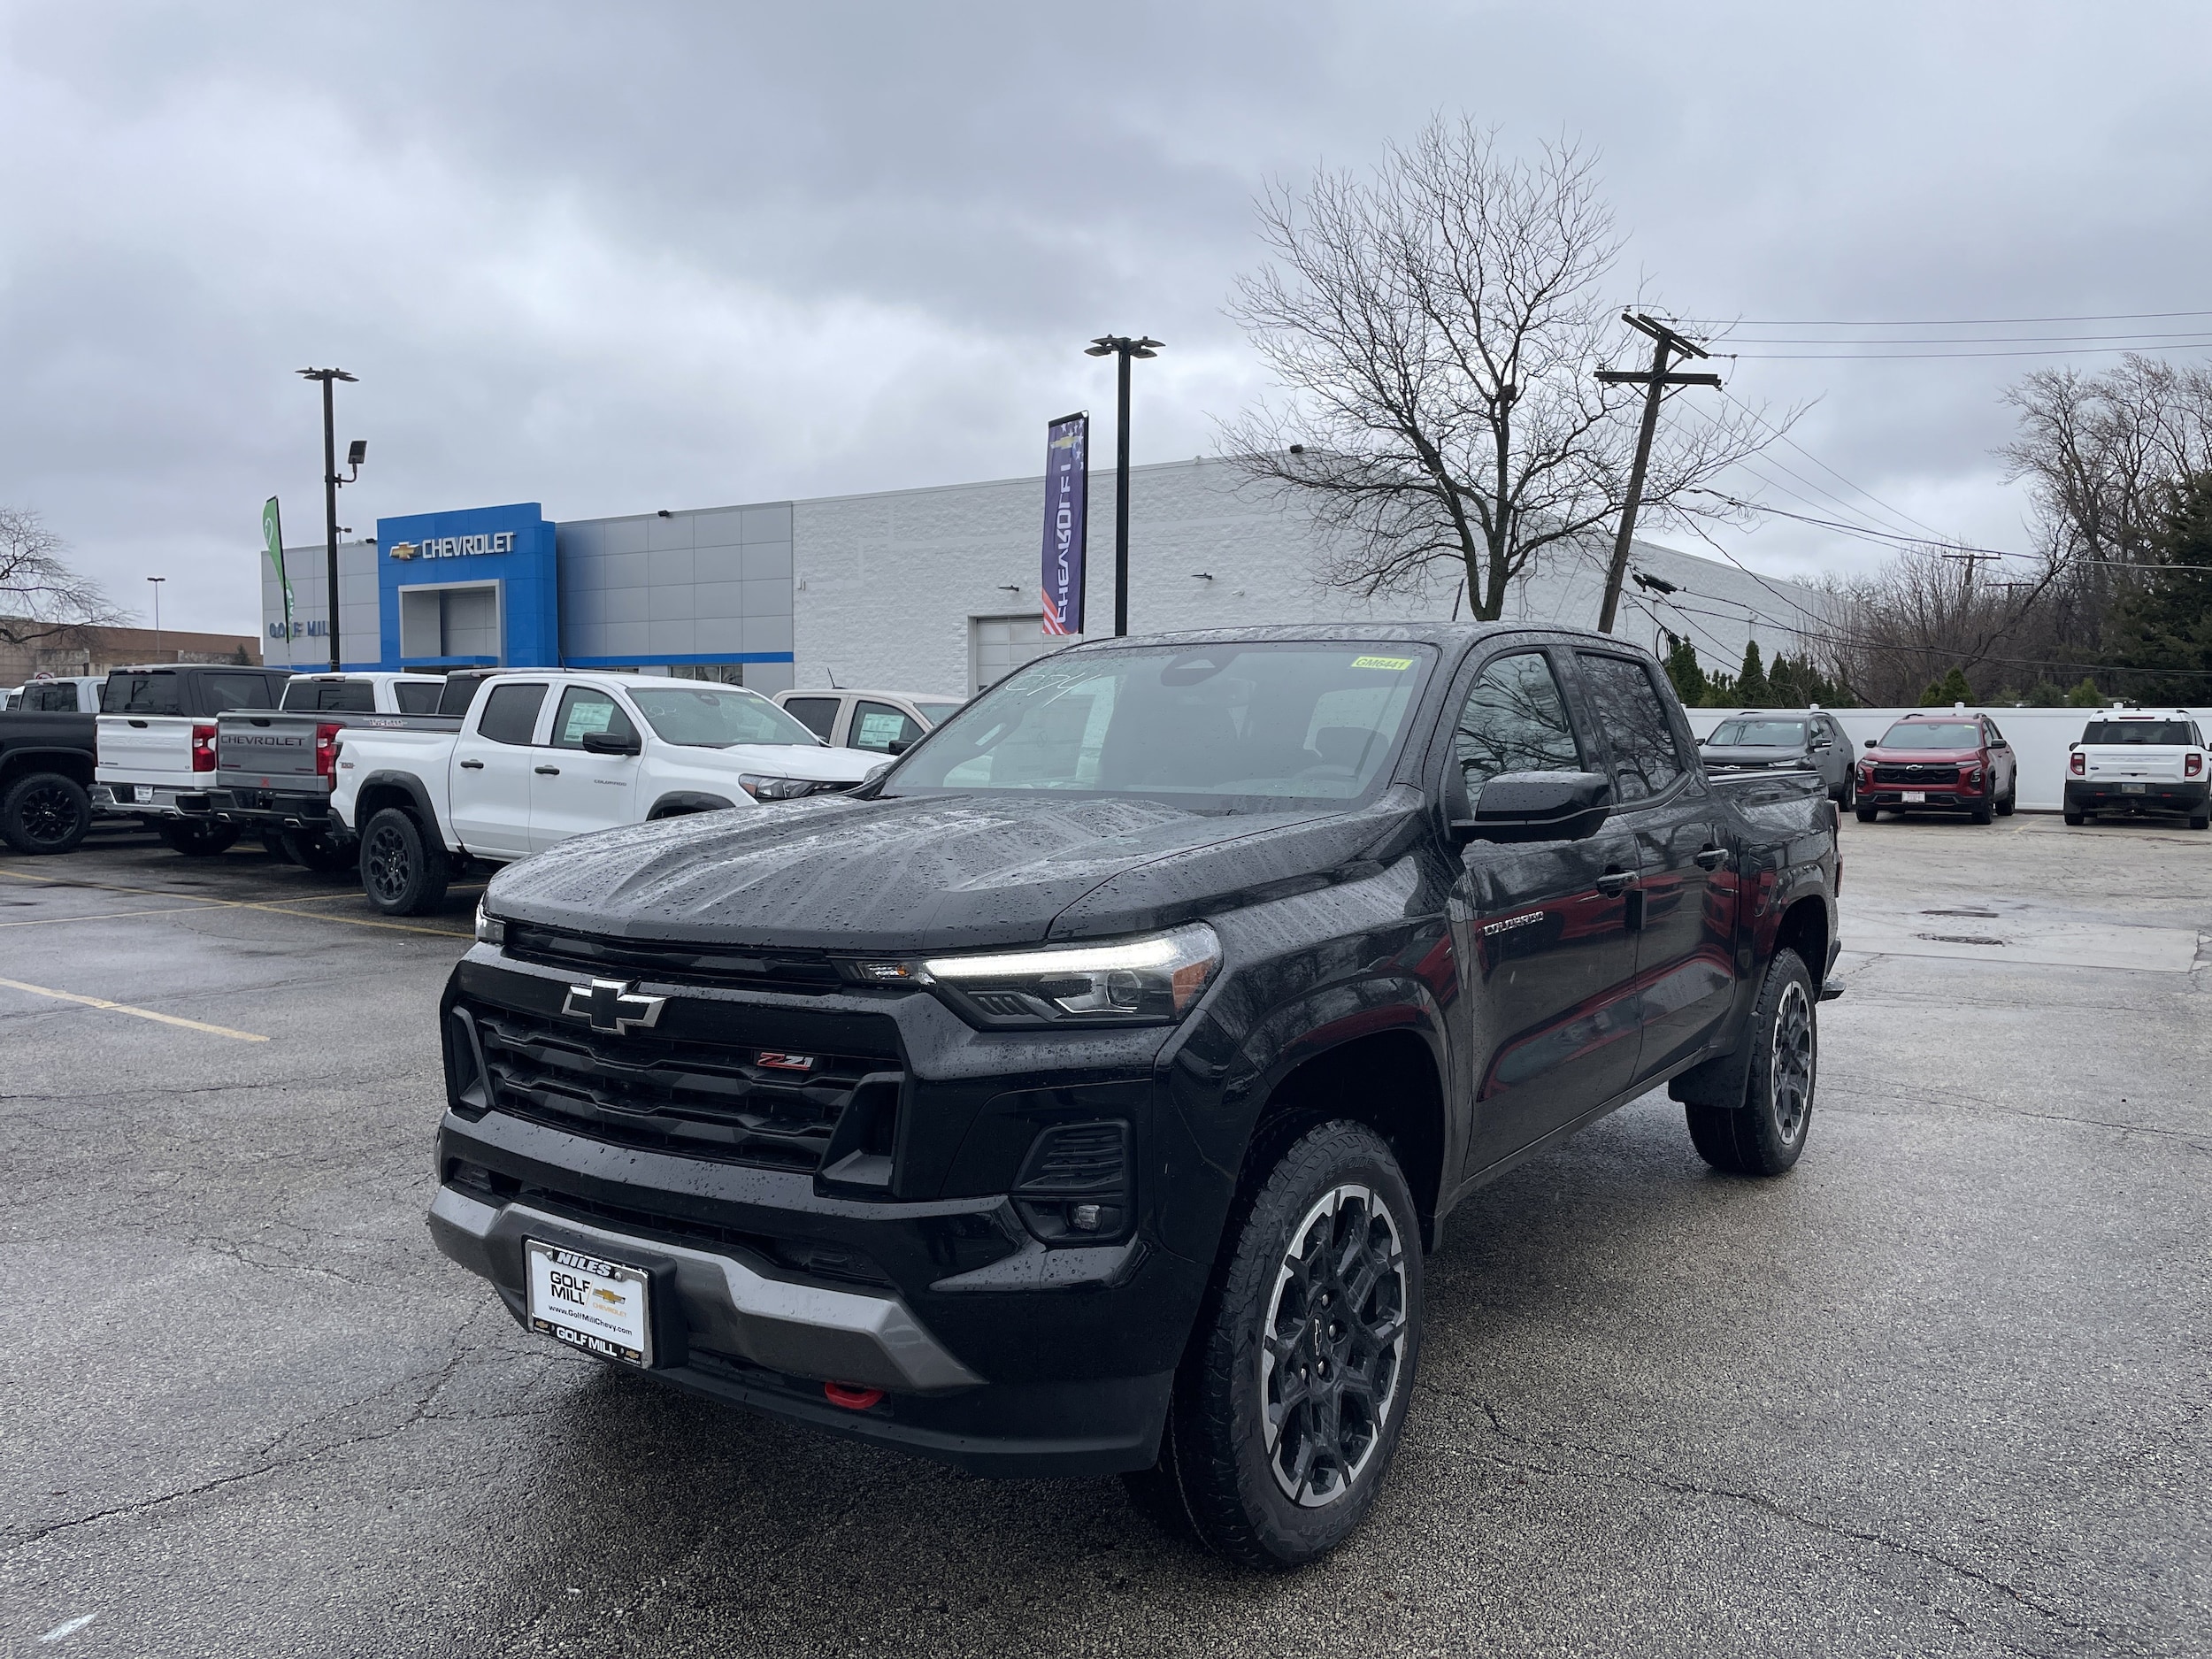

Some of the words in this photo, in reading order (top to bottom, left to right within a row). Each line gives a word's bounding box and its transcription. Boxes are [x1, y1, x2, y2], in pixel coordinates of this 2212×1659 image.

[422, 532, 514, 559] CHEVROLET
[269, 621, 303, 638] GOF
[307, 620, 331, 637] MIL
[1356, 658, 1405, 669] GM6441
[221, 735, 305, 747] CHEVROLET
[1484, 911, 1544, 936] COLORADO
[757, 1052, 814, 1071] Z71
[557, 1252, 611, 1277] NILES
[549, 1271, 591, 1293] GOLF
[551, 1285, 585, 1306] MILL
[592, 1302, 627, 1317] CHEVROLET
[548, 1305, 633, 1336] www.GolfMillChevy.com
[556, 1327, 588, 1346] GOLF
[588, 1337, 618, 1357] MILL
